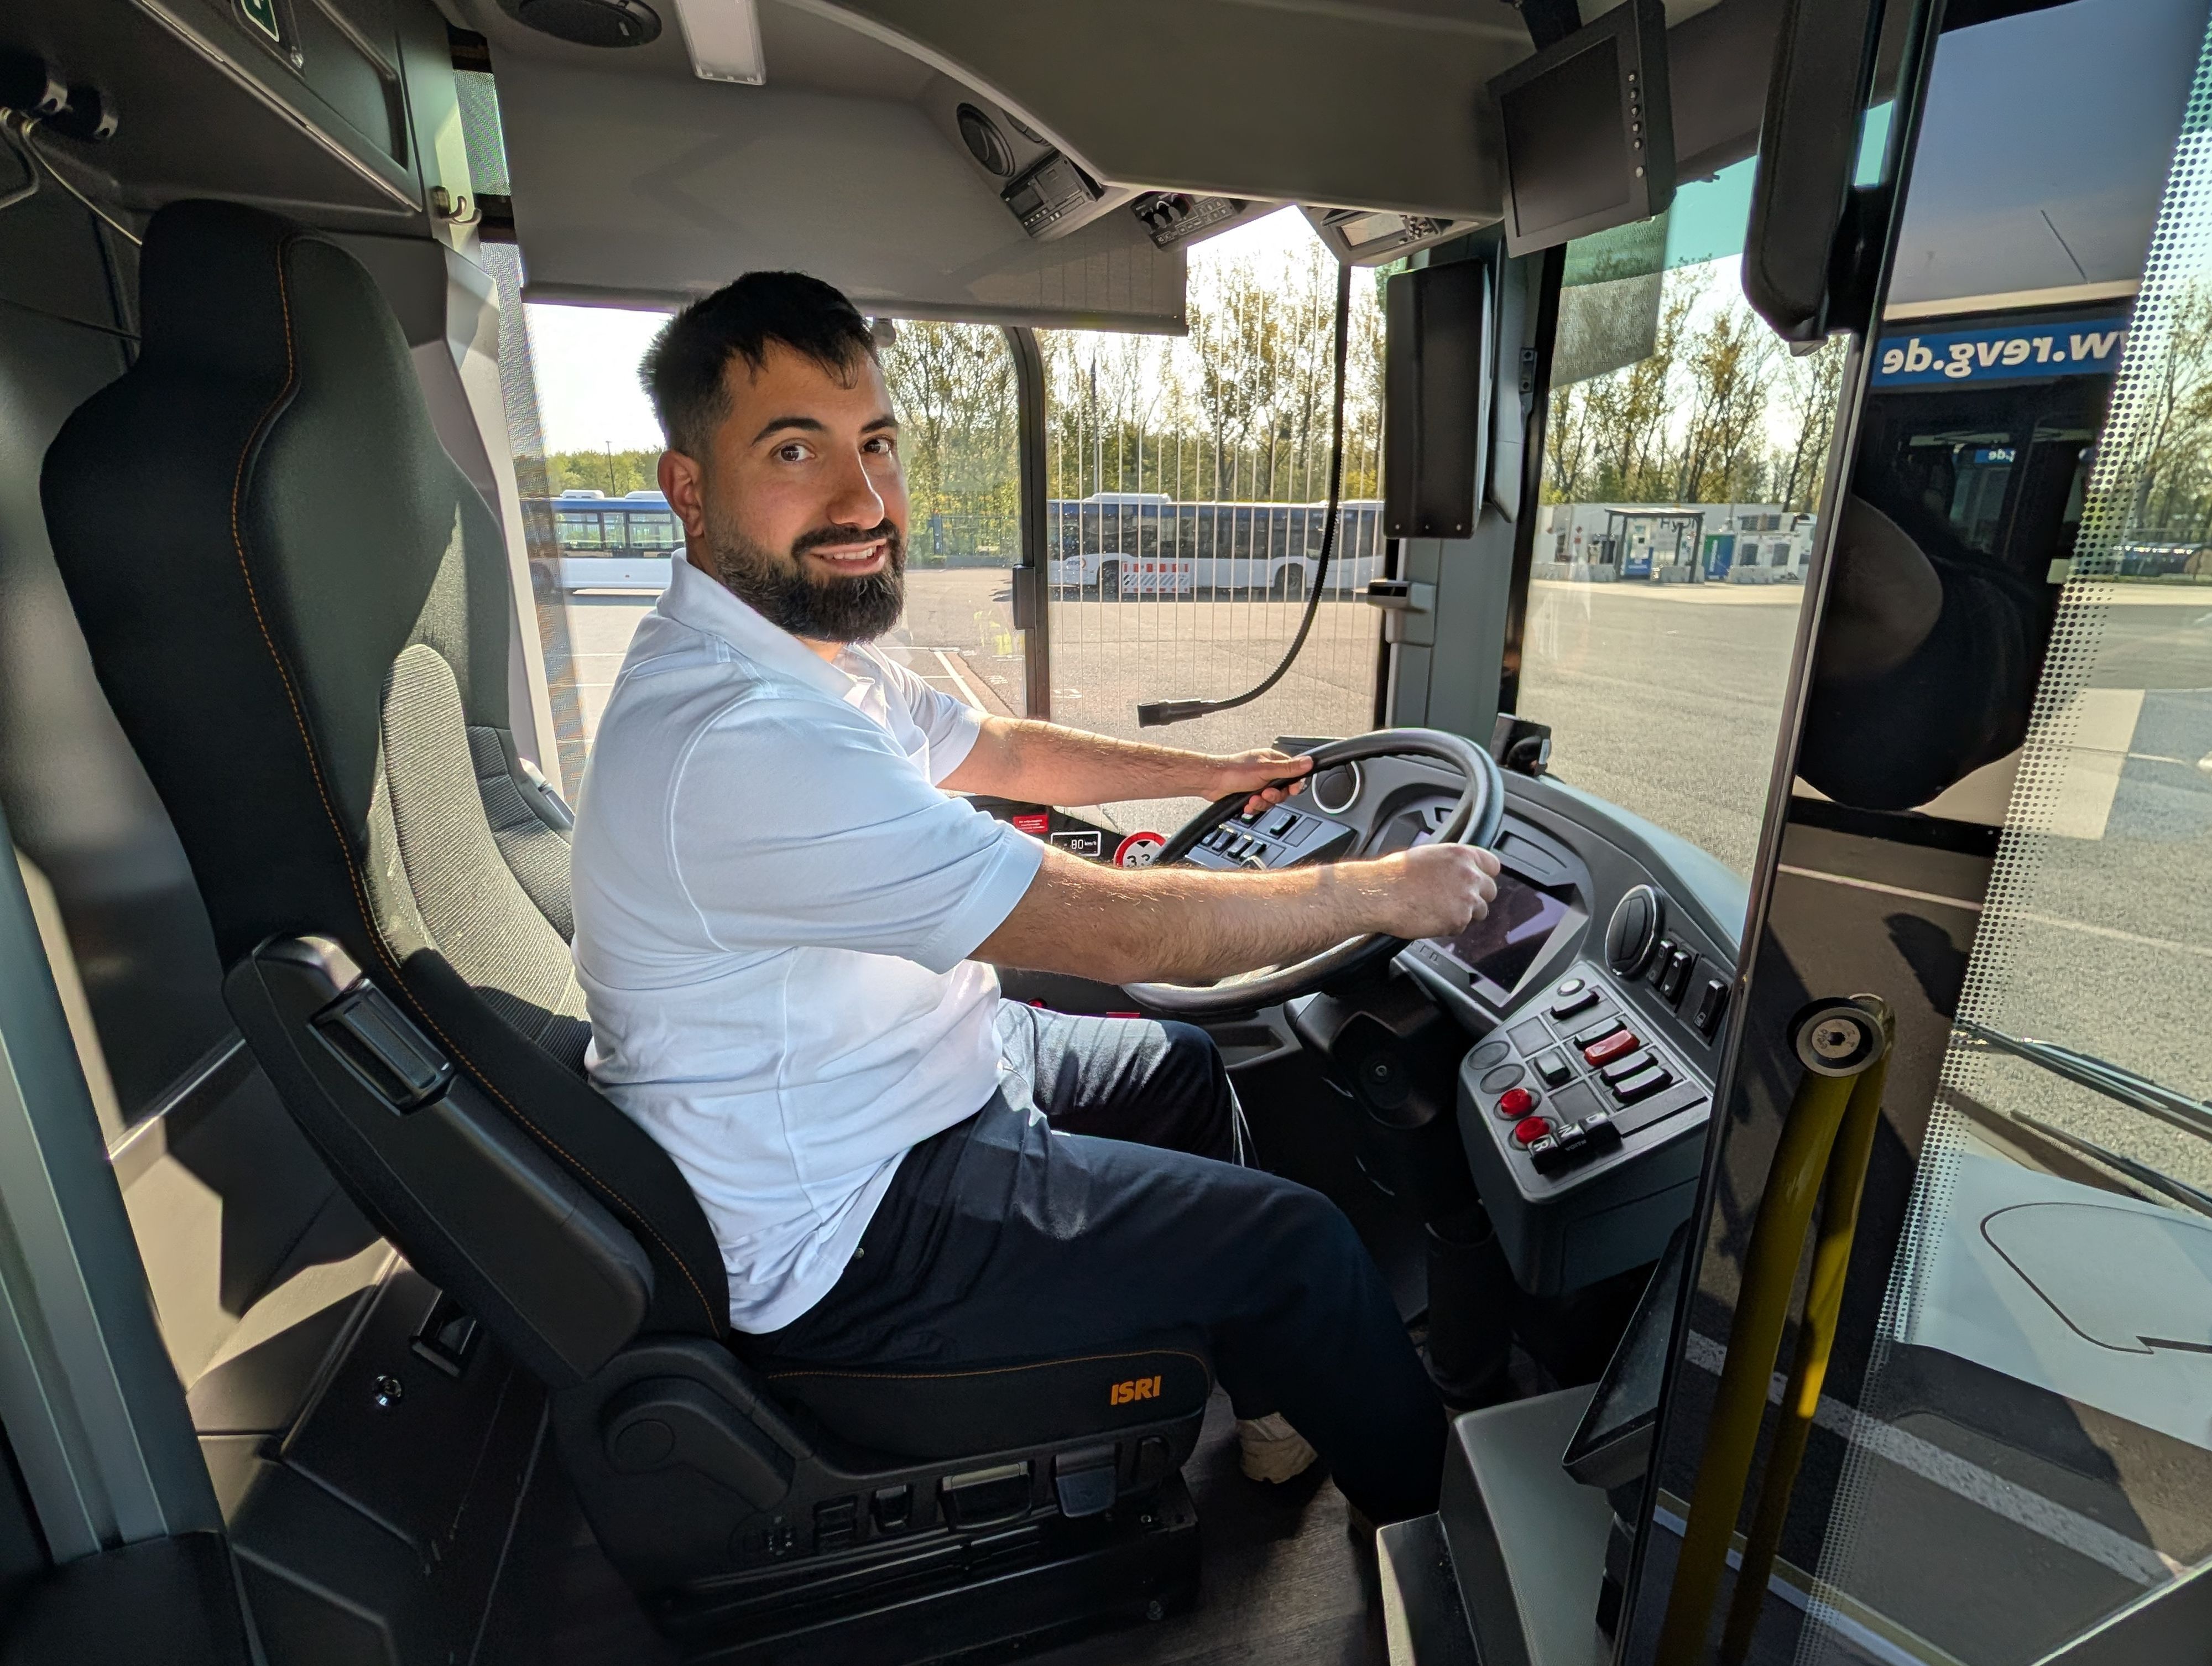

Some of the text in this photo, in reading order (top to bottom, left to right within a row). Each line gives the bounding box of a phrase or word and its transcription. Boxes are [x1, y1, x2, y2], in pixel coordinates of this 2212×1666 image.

[1071, 839, 1084, 850] 80
[1533, 1139, 1549, 1152] R
[1110, 1376, 1161, 1405] ISRI
